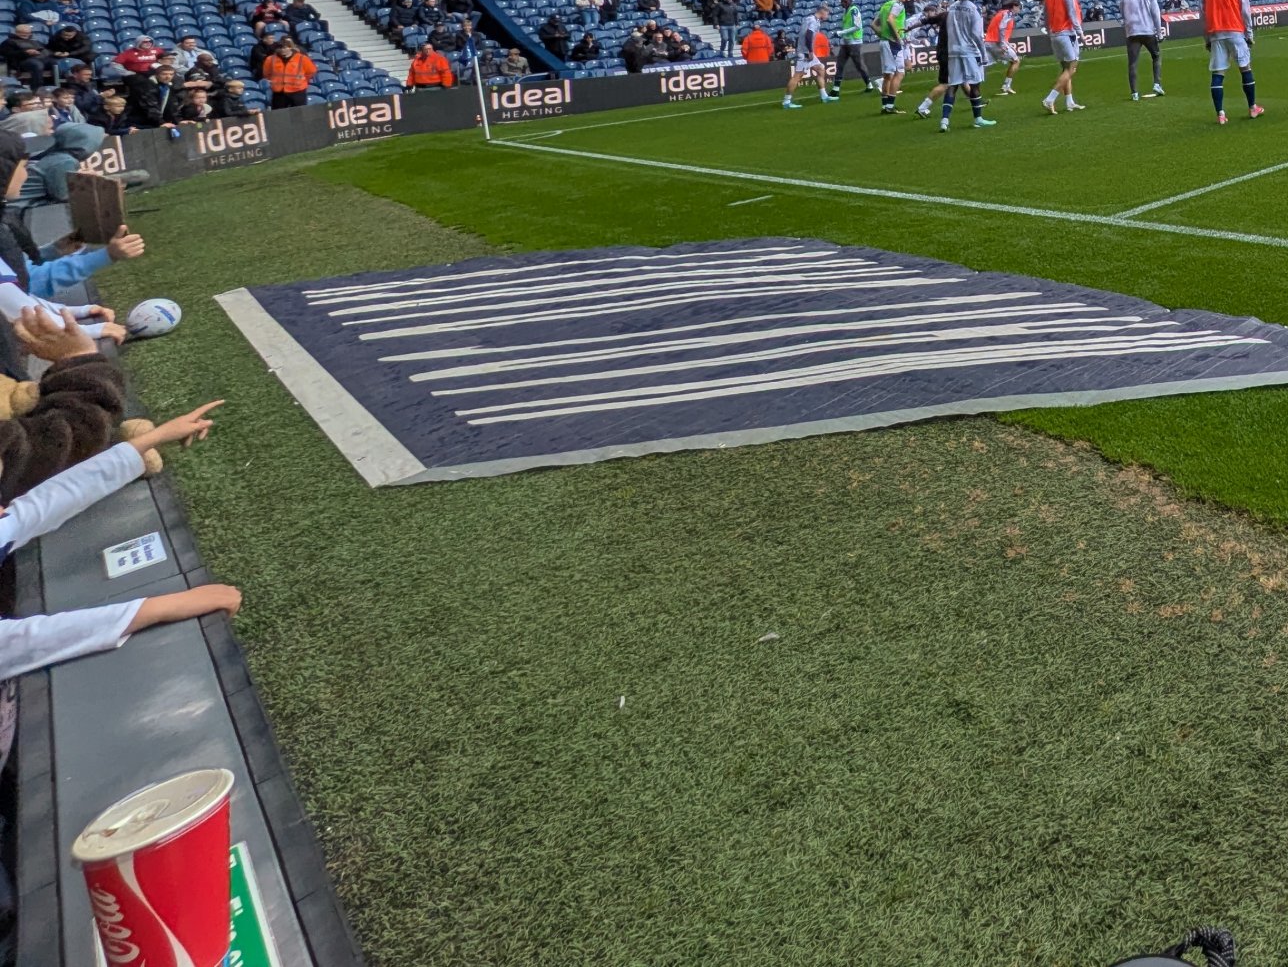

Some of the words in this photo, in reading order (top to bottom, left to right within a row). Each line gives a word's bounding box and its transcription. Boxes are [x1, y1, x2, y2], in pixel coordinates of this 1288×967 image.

[1253, 11, 1278, 26] ideal
[673, 59, 733, 71] BROMWICH
[660, 66, 726, 93] ideal
[491, 79, 572, 110] ideal
[669, 90, 719, 102] HEATING
[328, 94, 402, 129] ideal
[502, 106, 563, 119] HEATING
[196, 112, 268, 154] ideal
[337, 124, 393, 139] HEATING
[80, 135, 127, 174] eal
[210, 148, 263, 166] HEATING
